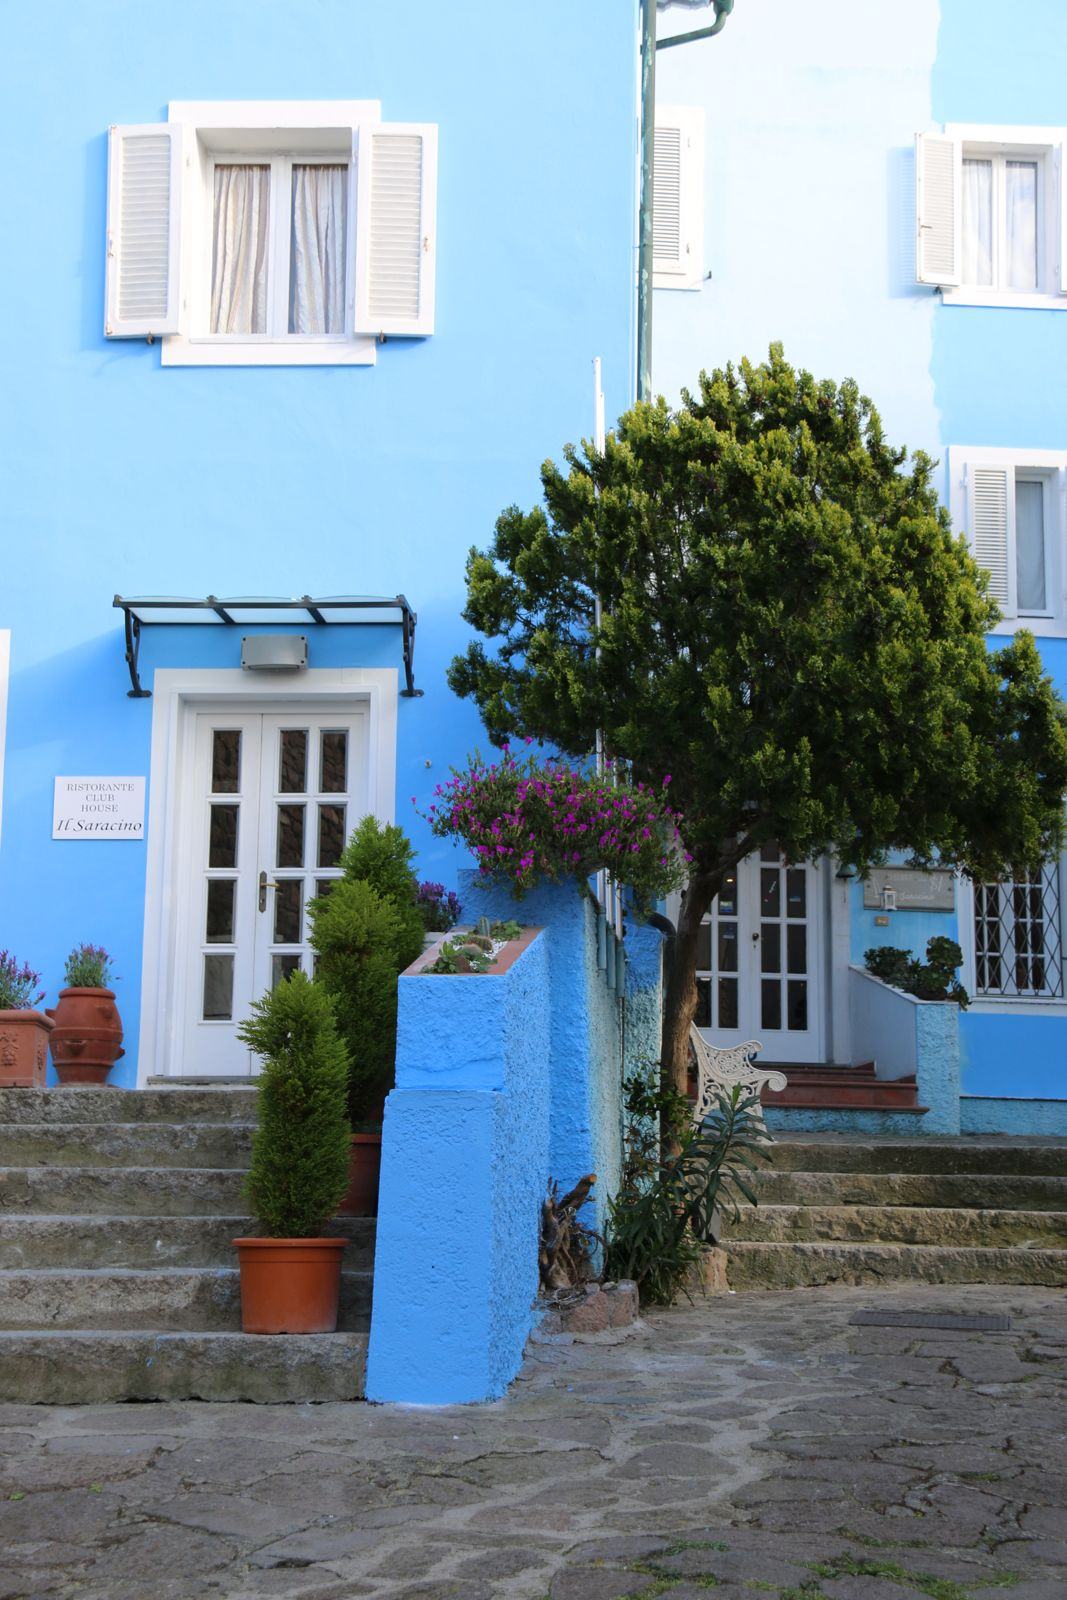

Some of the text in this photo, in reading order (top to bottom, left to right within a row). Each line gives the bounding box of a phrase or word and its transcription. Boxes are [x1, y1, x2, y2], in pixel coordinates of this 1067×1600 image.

[66, 783, 135, 792] RISTORANTE
[85, 794, 115, 802] CLUB
[81, 804, 119, 812] HOUSE
[57, 818, 142, 832] Il Saracino
